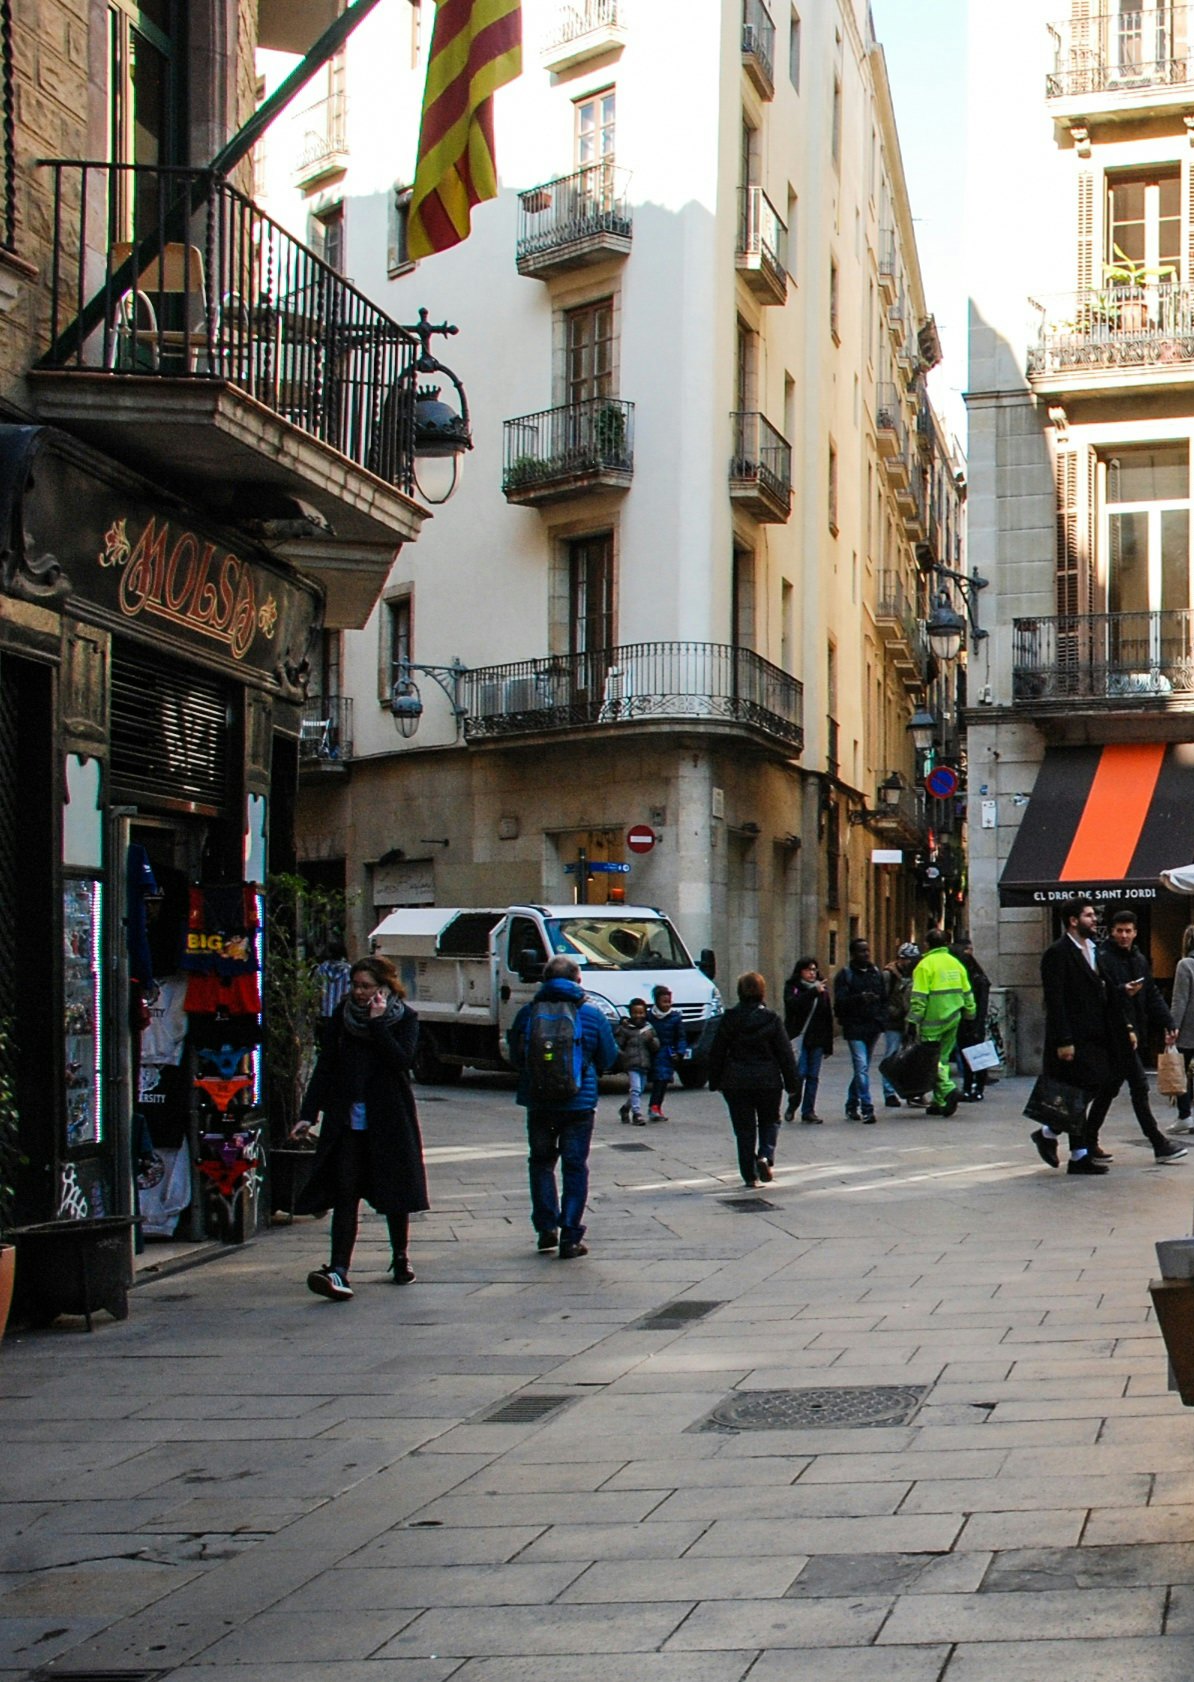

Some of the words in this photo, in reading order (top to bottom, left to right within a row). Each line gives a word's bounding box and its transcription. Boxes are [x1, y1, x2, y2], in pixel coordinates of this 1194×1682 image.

[119, 515, 257, 660] MOLSA
[1033, 891, 1046, 901] EL
[1048, 891, 1076, 900] DRAC
[1095, 889, 1122, 900] SANT
[1125, 888, 1156, 899] JORDI
[187, 933, 223, 951] BIG
